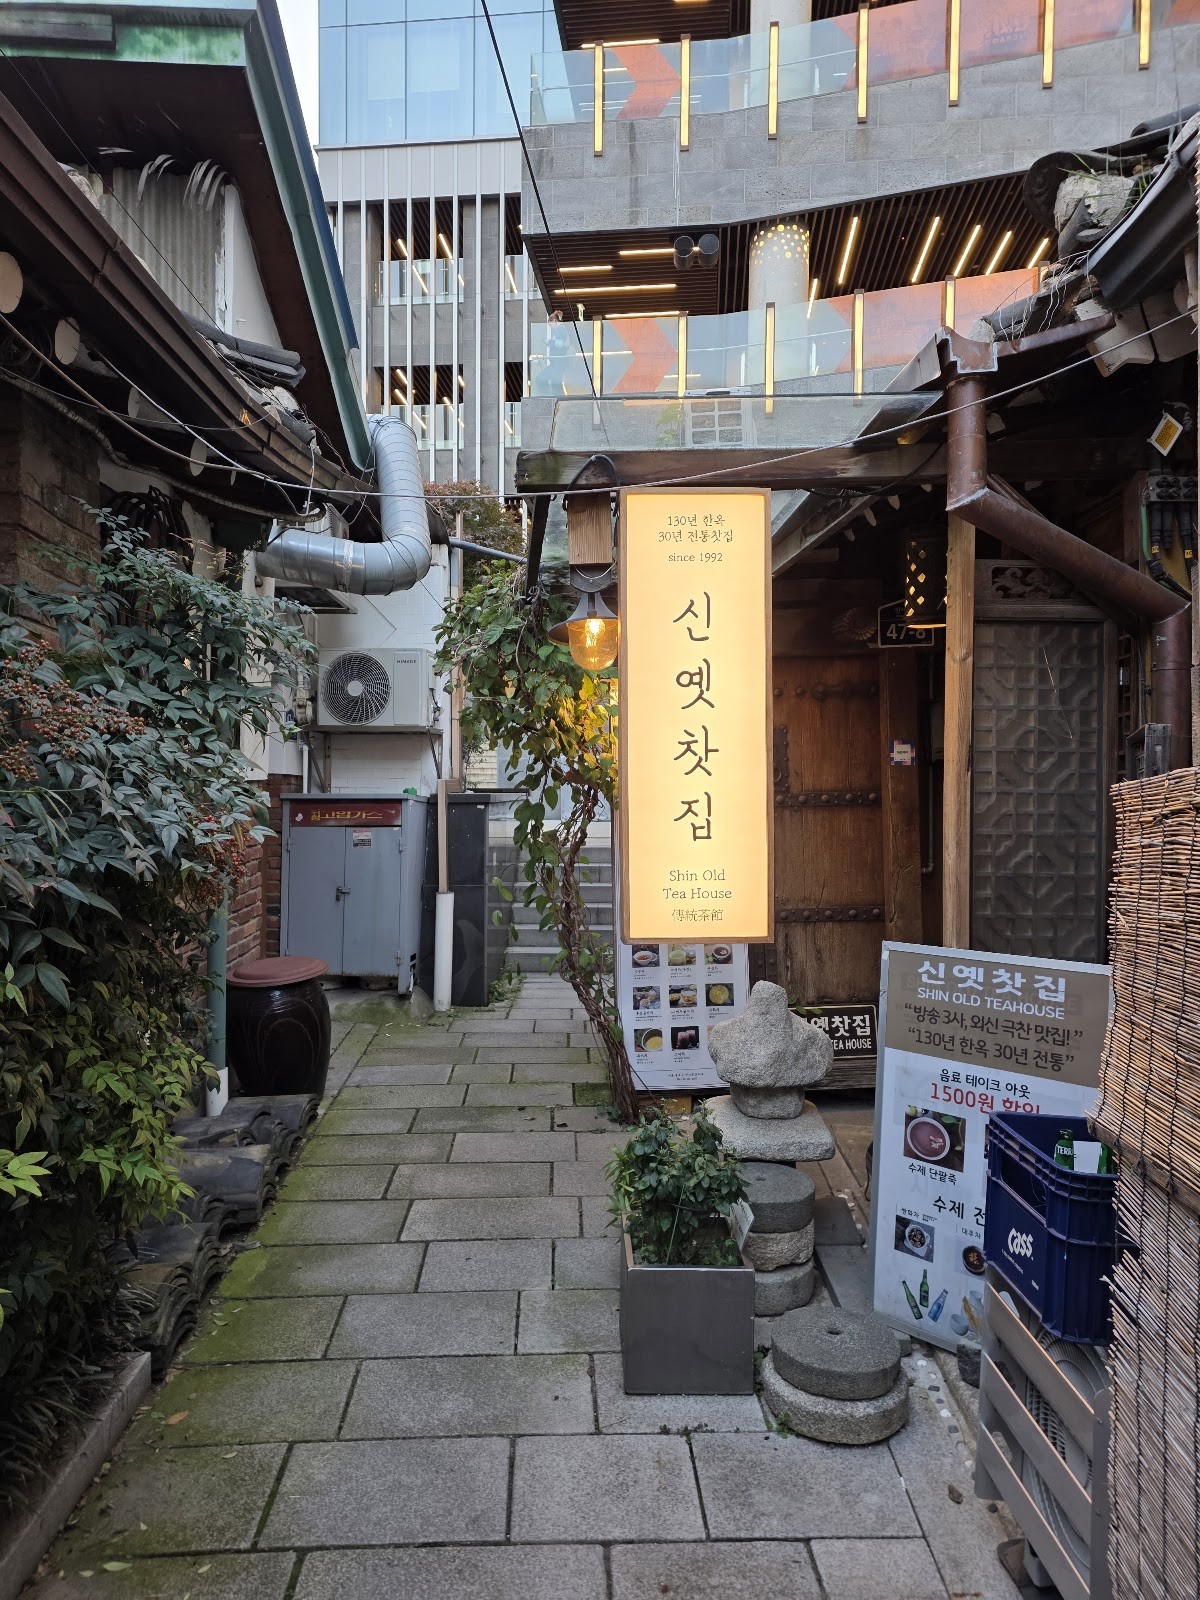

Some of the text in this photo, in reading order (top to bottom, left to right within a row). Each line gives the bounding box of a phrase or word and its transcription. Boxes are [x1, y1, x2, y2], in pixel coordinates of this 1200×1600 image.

[667, 513, 726, 527] 130년 한옥
[658, 528, 734, 543] 30년 전통찻집
[668, 552, 723, 562] since 1992
[669, 869, 726, 882] Shin Old
[662, 887, 733, 900] Tea House
[917, 987, 1065, 1020] SHIN OLD TEAHOUSE
[803, 1014, 871, 1037] 옛찻집
[845, 1038, 872, 1050] HOUSE
[959, 1036, 989, 1059] 한옥
[993, 1043, 1028, 1066] 30년
[939, 1068, 1031, 1100] 음료 테이크 아웃
[930, 1082, 995, 1115] 1500원
[908, 1162, 957, 1186] 수제 단팥죽
[932, 1195, 965, 1220] 수제
